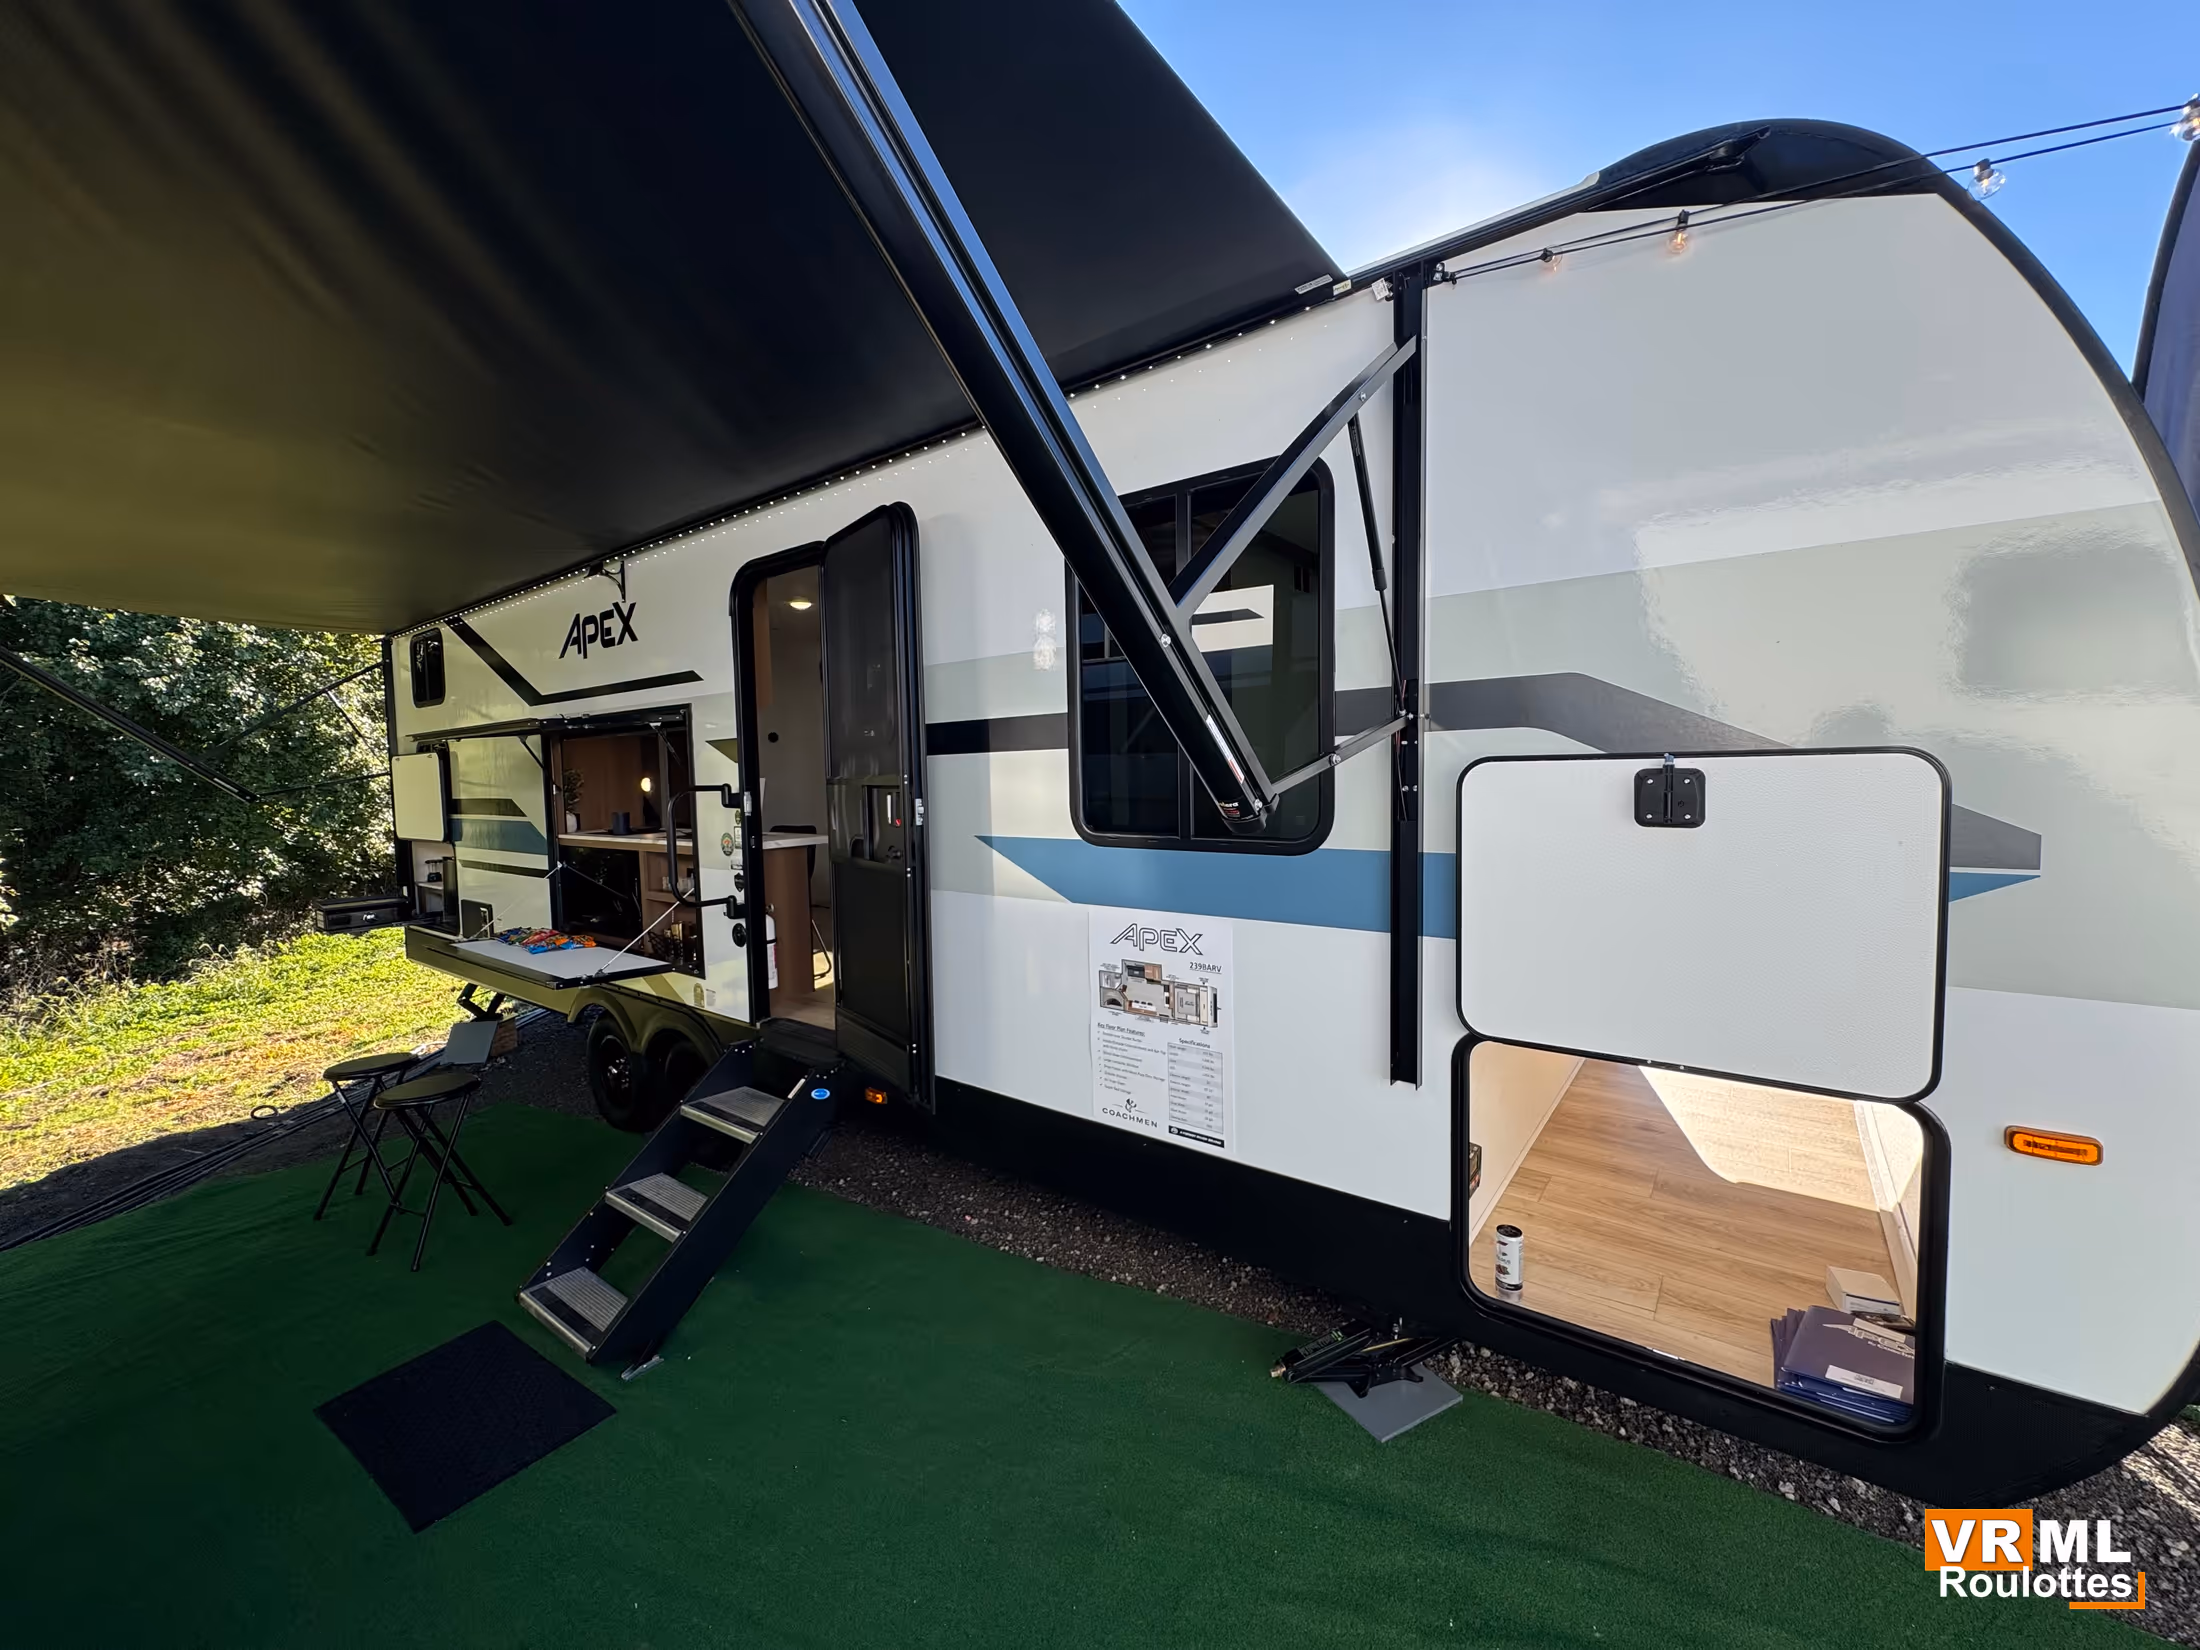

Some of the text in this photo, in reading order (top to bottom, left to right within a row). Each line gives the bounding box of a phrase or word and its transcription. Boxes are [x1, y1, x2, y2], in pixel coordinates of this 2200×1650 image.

[559, 601, 639, 660] APEX
[1110, 922, 1204, 956] APEX
[1101, 1107, 1158, 1128] COACHMEN
